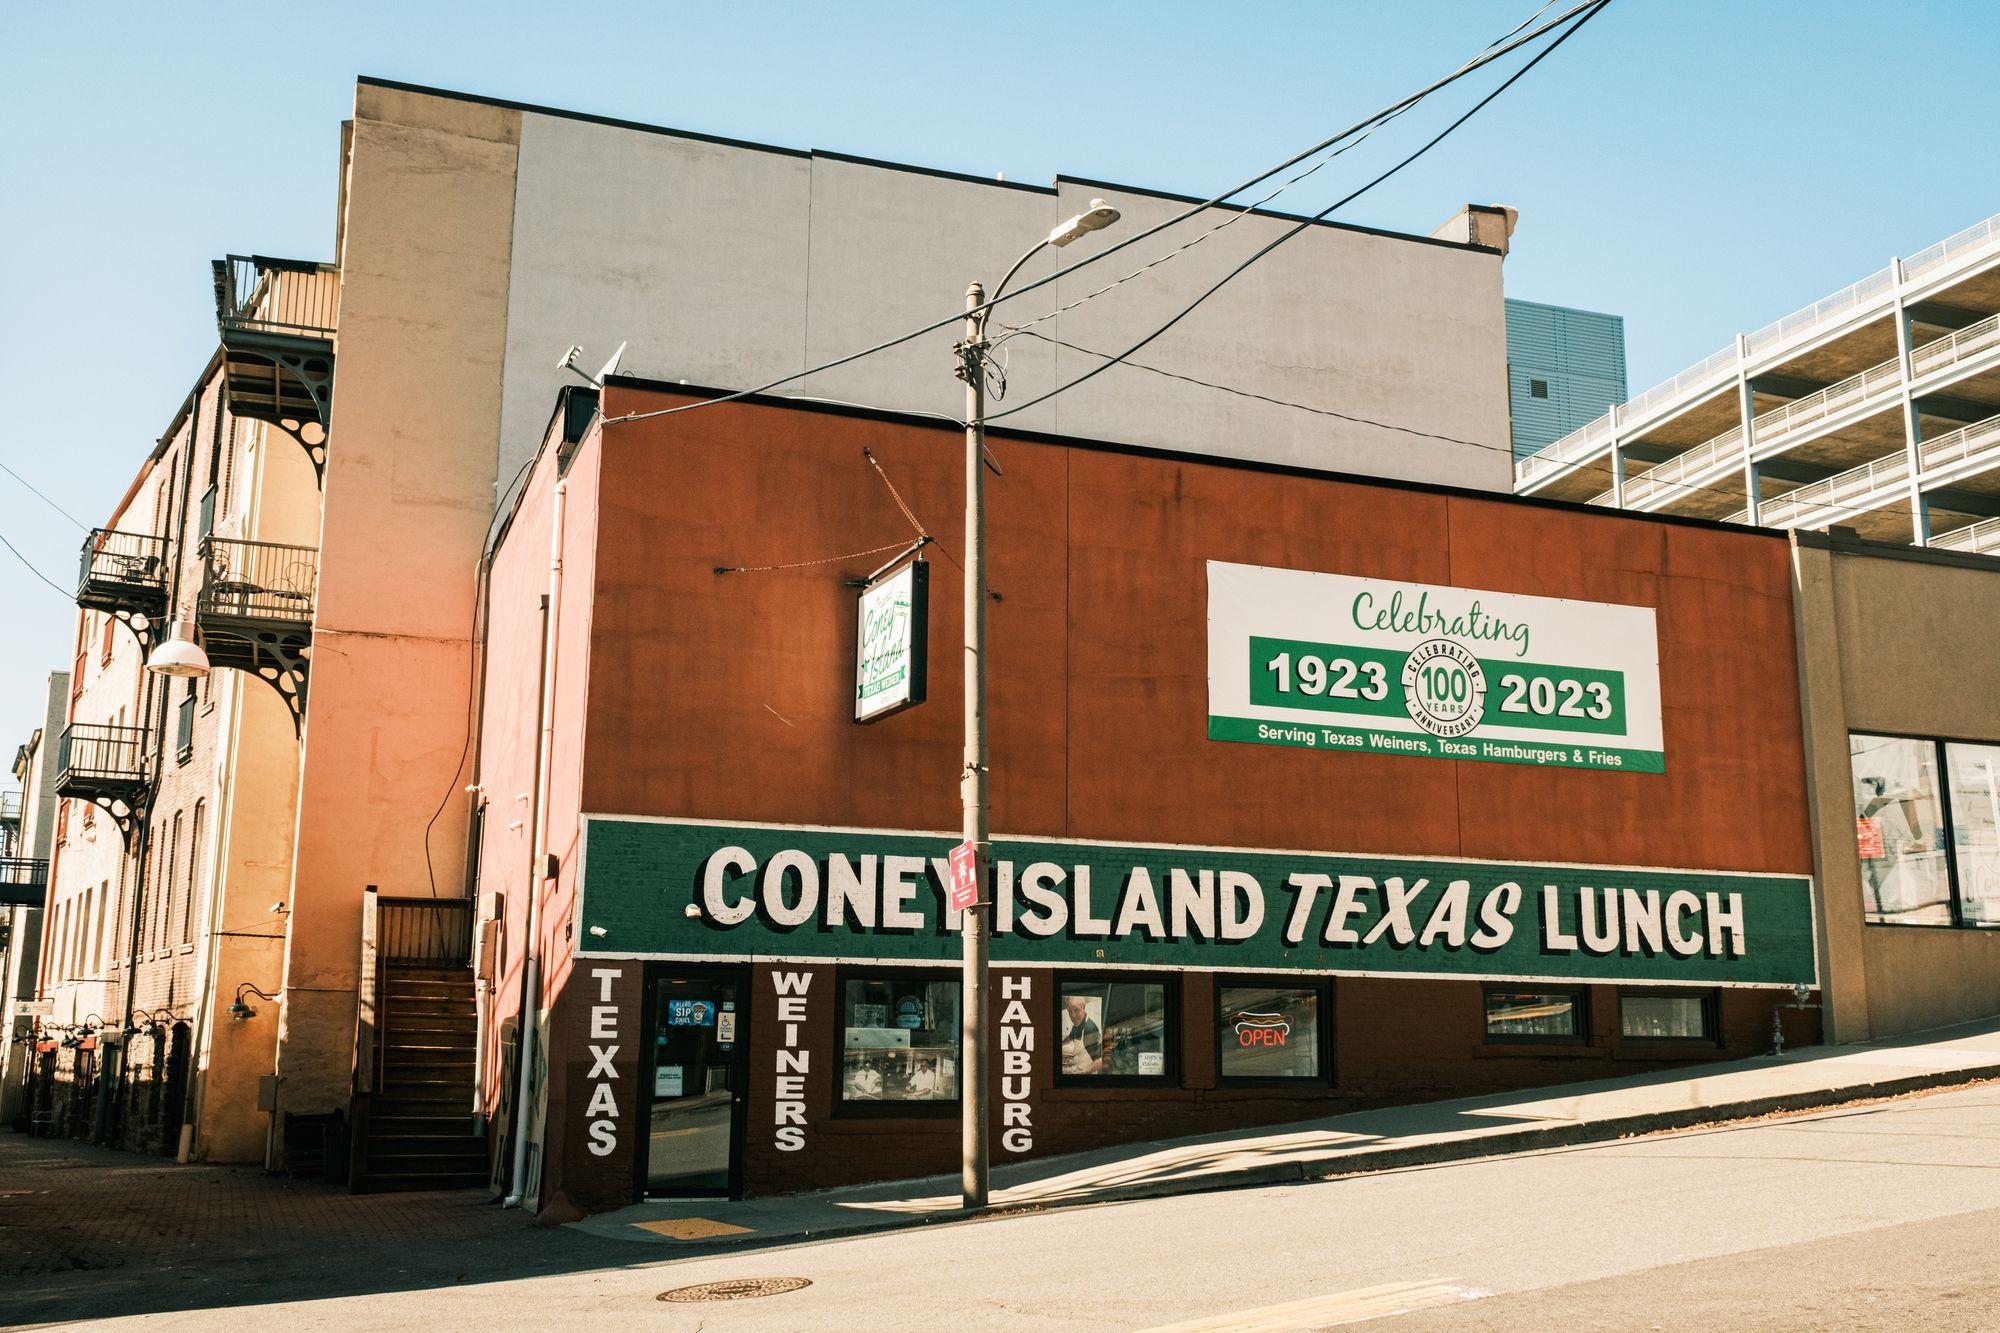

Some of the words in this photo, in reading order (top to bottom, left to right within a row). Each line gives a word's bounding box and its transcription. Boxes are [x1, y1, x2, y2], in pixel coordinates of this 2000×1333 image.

[1351, 590, 1530, 657] Celebrating
[1266, 652, 1389, 702] 1923
[1407, 643, 1480, 678] CELEBRATING
[1421, 666, 1467, 703] 100
[1499, 674, 1613, 720] 2023
[1415, 710, 1477, 735] ANNIVERSARY
[1426, 702, 1464, 714] YEARS
[1258, 723, 1316, 746] Serving
[1321, 730, 1364, 747] Texas
[1369, 734, 1432, 755] Weiners,
[1436, 739, 1477, 756] Texas
[1482, 742, 1567, 765] Hamburgers
[1572, 748, 1584, 763] &
[1588, 750, 1622, 767] Fries
[997, 861, 1266, 940] ISLAND
[1286, 873, 1522, 949] TEXAS
[1543, 884, 1747, 956] LUNCH
[675, 1007, 691, 1017] SIP
[1239, 1028, 1286, 1047] OPEN
[585, 968, 622, 1157] TEXAS
[772, 970, 813, 1153] WEINERS
[1000, 976, 1034, 1154] HAMBURG
